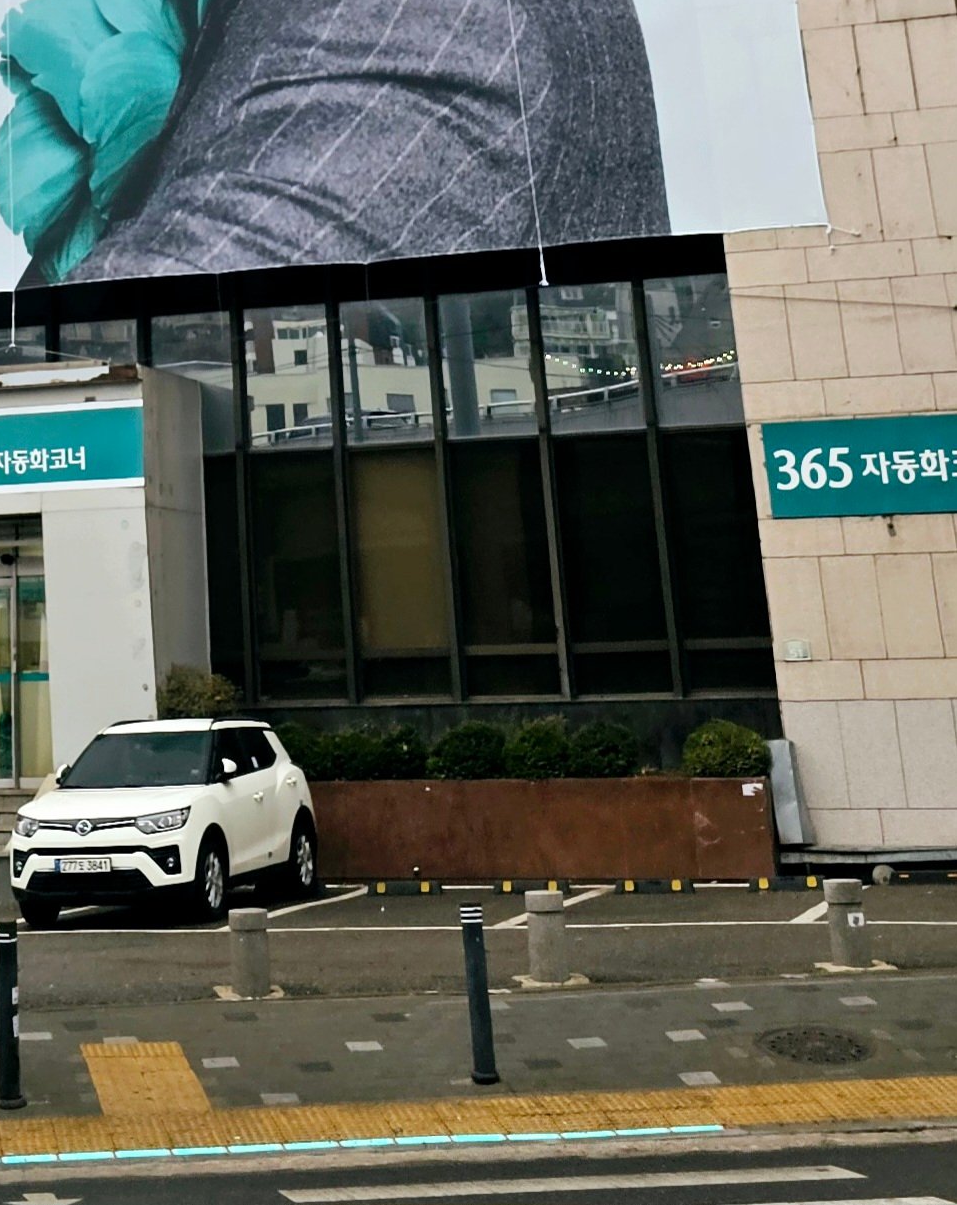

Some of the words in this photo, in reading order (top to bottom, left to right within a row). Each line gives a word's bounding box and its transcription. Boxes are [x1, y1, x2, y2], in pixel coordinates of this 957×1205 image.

[772, 447, 854, 491] 365
[860, 448, 957, 485] 자동화
[87, 860, 108, 871] 3841
